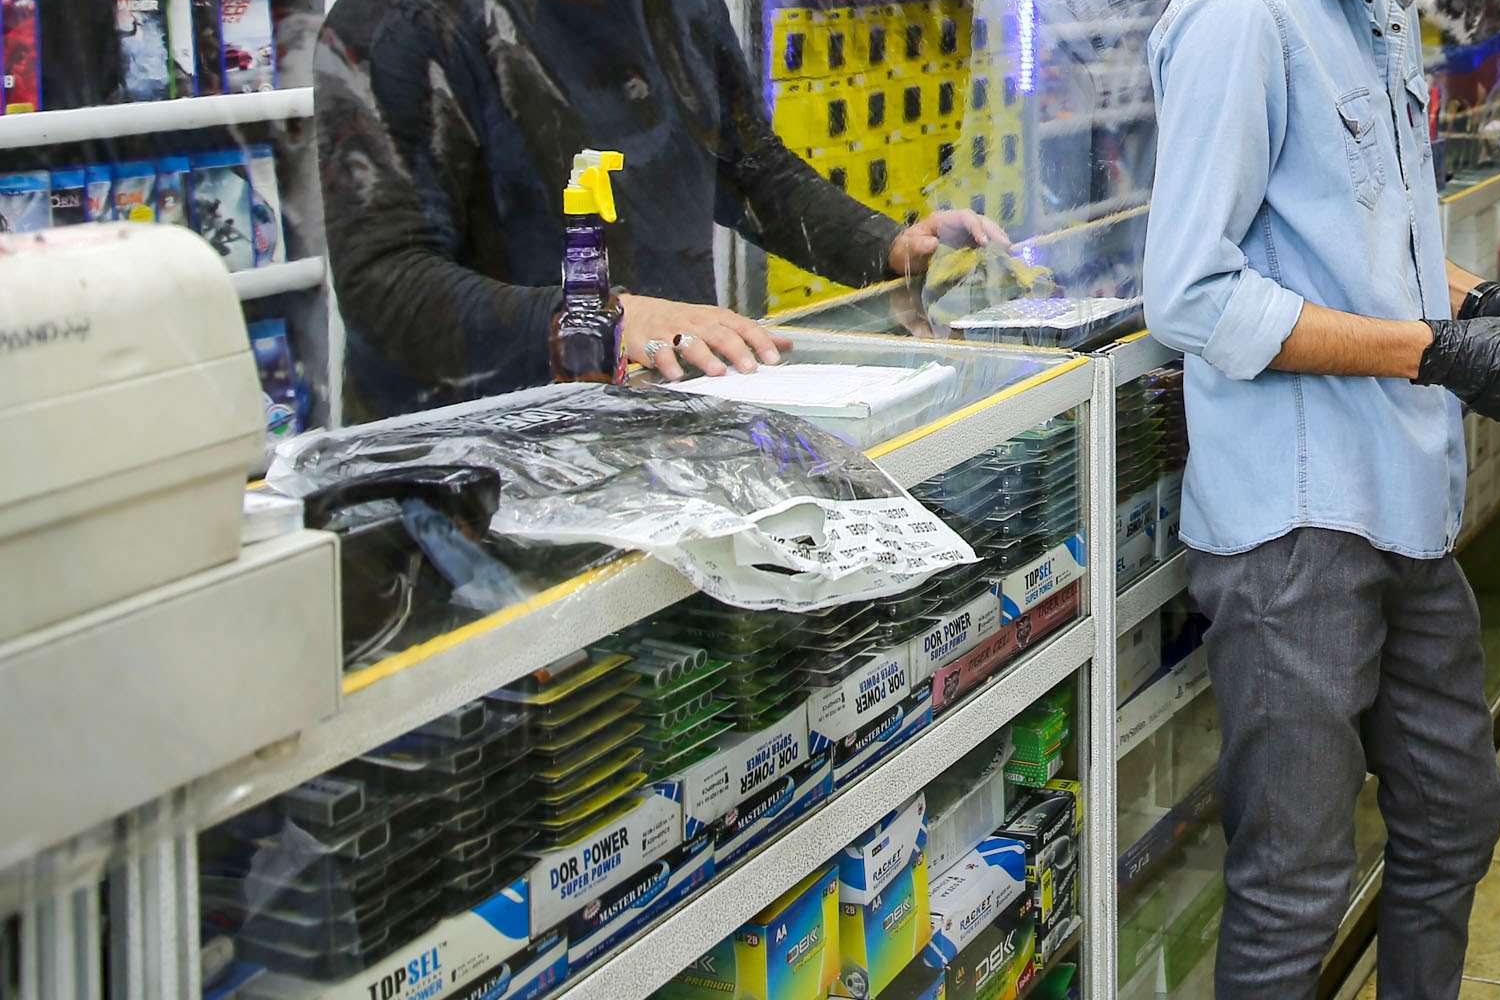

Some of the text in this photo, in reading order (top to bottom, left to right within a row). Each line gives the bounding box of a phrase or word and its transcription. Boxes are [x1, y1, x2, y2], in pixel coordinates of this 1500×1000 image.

[908, 521, 938, 534] DIESEL
[1024, 561, 1054, 590] TOPSEL
[924, 631, 943, 654] DOR
[944, 612, 972, 645] POWER
[930, 631, 968, 662] SUPER POWER
[859, 661, 899, 694] SUPER POWER
[889, 669, 906, 695] DOR
[856, 685, 887, 715] POWER
[746, 733, 793, 770] SUPER POWER
[778, 742, 799, 769] DOR
[740, 757, 776, 795] POWER
[736, 801, 768, 830] MASTER
[550, 856, 579, 890] DOR
[583, 827, 630, 870] POWER
[872, 848, 901, 882] RACKET
[560, 853, 622, 900] SUPER POWER
[598, 889, 635, 925] MASTER
[959, 894, 992, 931] RACKET
[775, 923, 788, 944] AA
[367, 946, 442, 1000] TOPSEL
